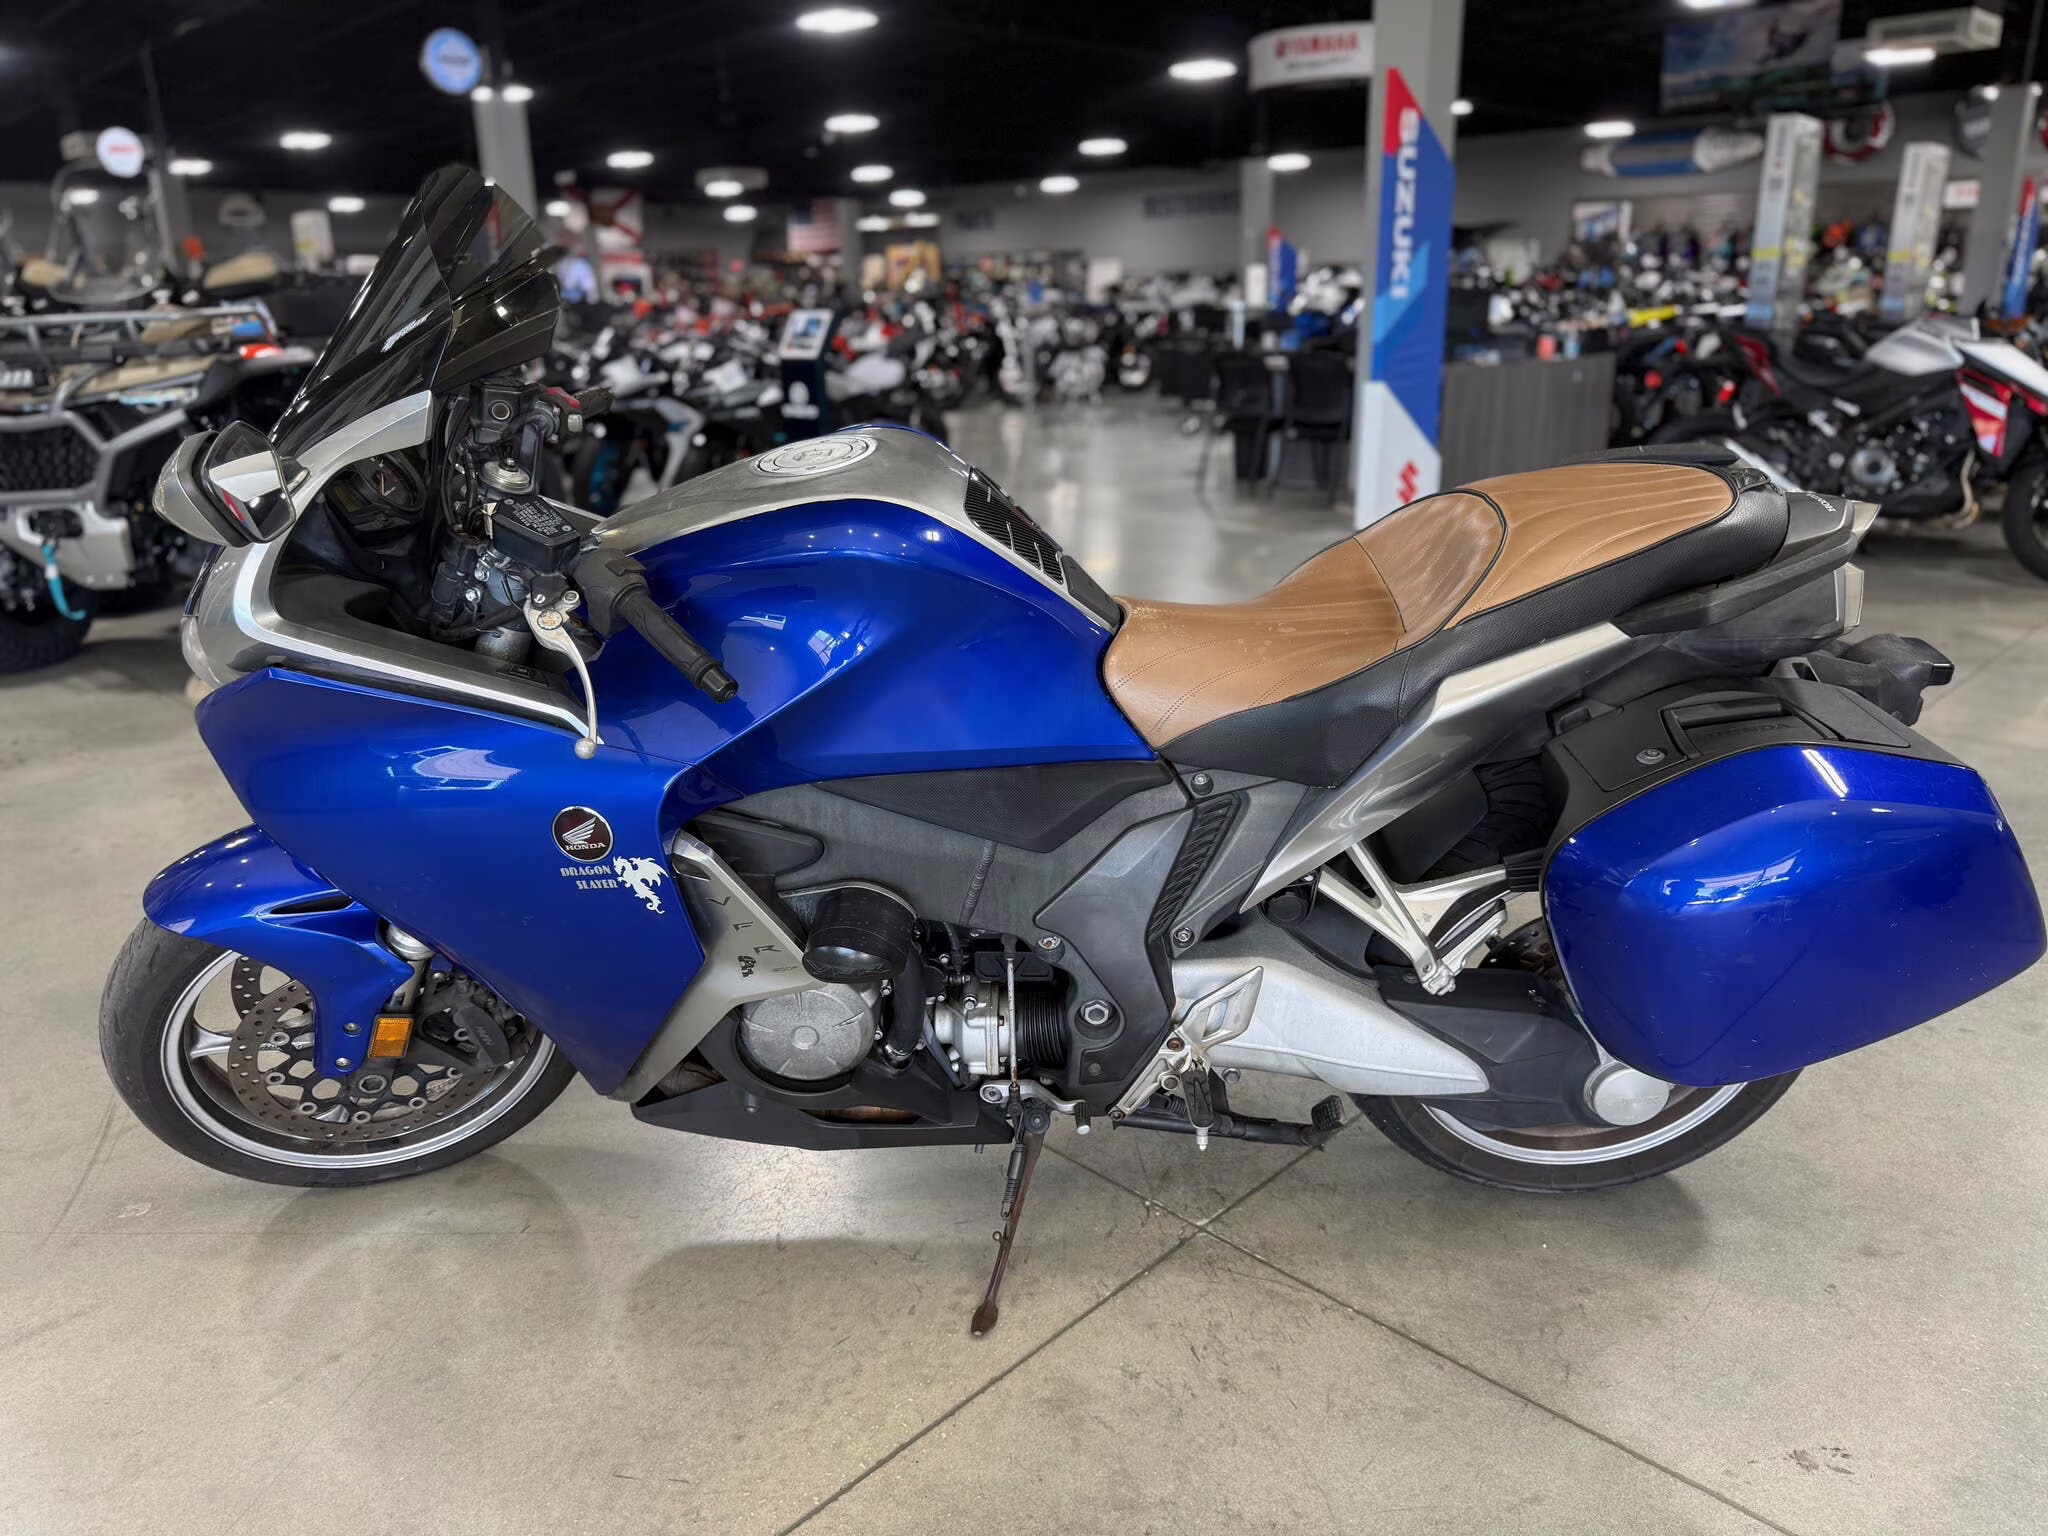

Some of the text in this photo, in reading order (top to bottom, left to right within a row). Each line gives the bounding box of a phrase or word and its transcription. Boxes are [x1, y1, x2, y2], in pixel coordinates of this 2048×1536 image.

[1390, 107, 1420, 299] SUZUKI
[1806, 493, 1837, 512] HONDA
[565, 842, 606, 851] HONDA
[560, 865, 611, 877] DRAGON
[575, 879, 618, 890] SLAYER
